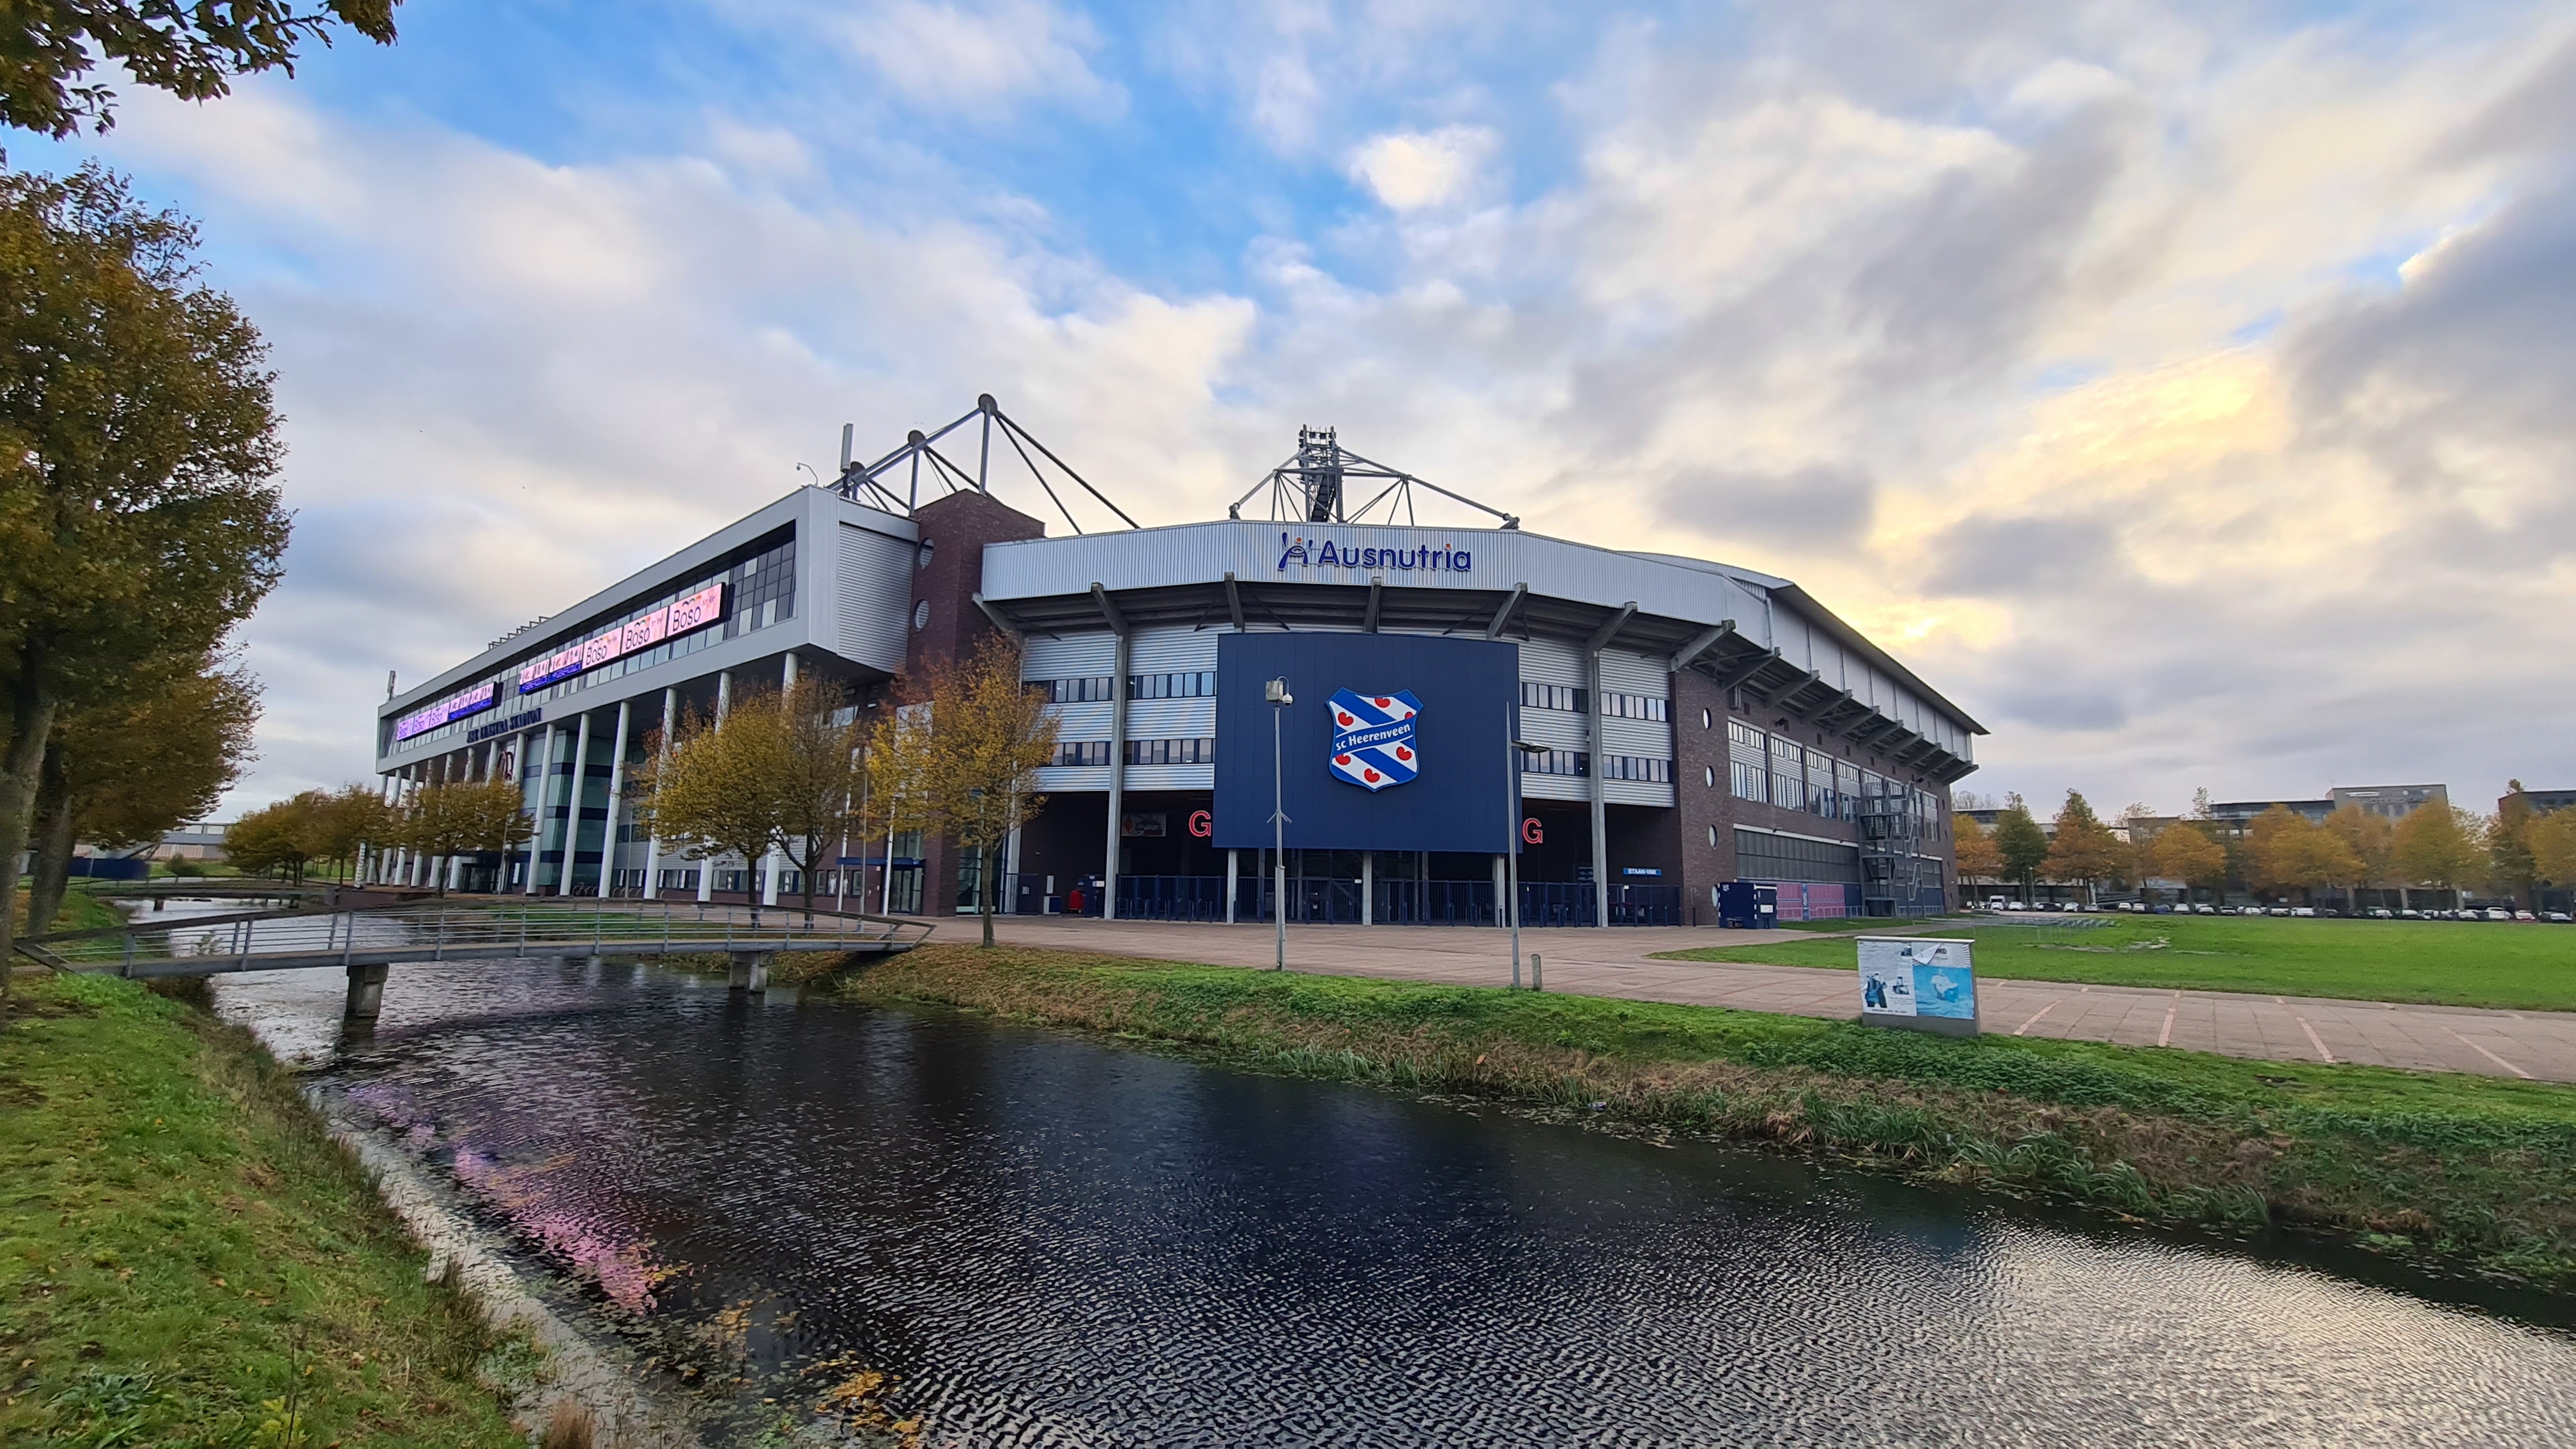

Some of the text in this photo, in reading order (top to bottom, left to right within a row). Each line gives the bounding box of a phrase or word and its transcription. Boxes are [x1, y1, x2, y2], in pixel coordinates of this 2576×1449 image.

[1317, 540, 1471, 571] Ausnutria
[673, 606, 701, 632] Boso
[625, 627, 650, 650] Boso
[586, 645, 607, 666] Boso
[1336, 724, 1411, 751] sc Heerenveen
[1189, 809, 1211, 837] G
[1522, 817, 1544, 844] G
